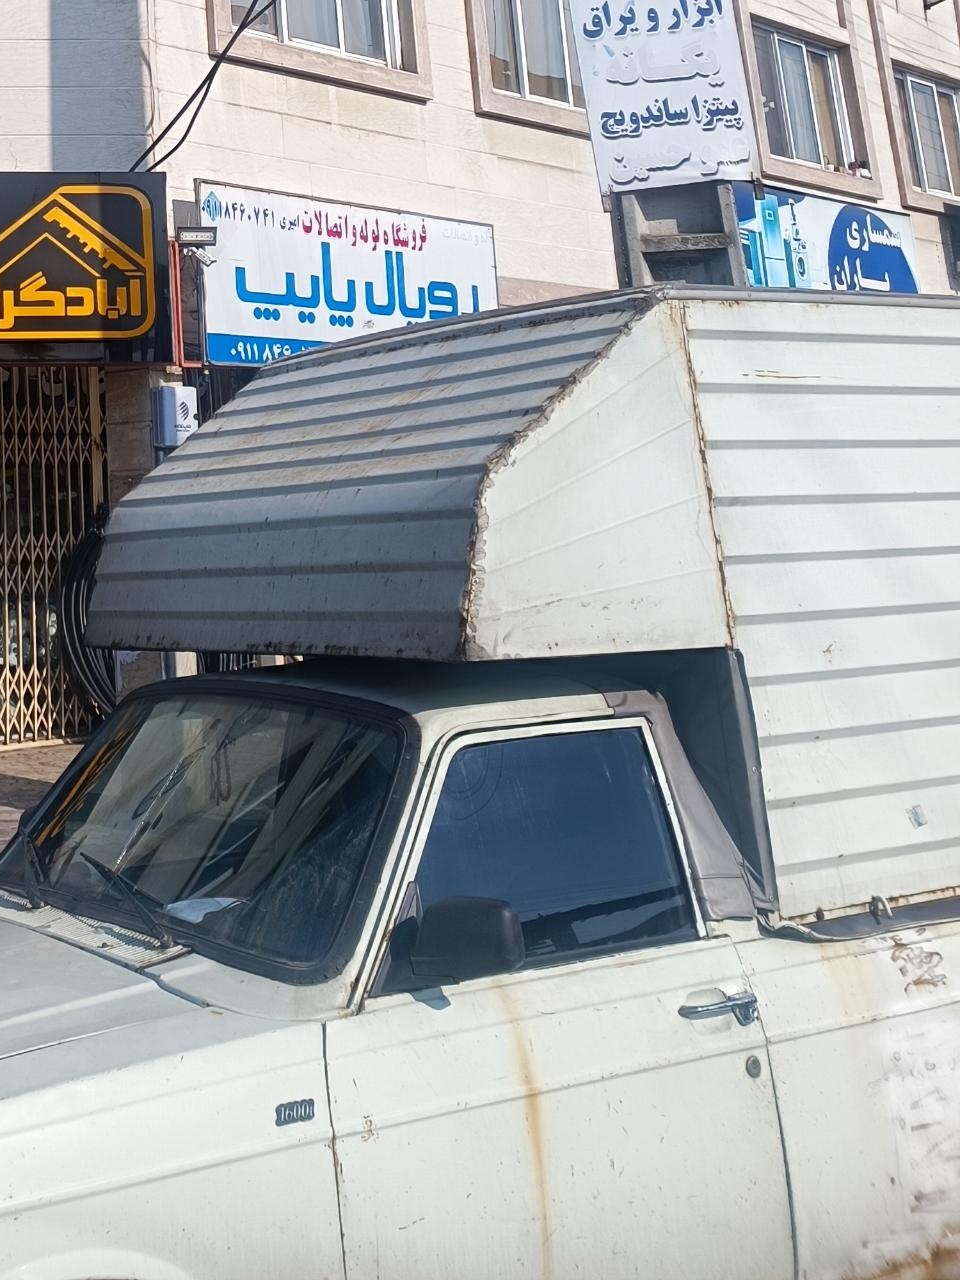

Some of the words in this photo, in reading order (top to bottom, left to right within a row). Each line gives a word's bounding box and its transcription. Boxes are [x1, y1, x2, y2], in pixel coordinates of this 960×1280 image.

[583, 0, 640, 39] یراق
[646, 7, 660, 33] و
[600, 97, 690, 138] ساندویچ
[692, 94, 744, 130] پیتزا
[201, 198, 276, 229] ۰۹۱۱۸۴۶۰۷۴۱
[302, 209, 349, 240] اتصالات
[351, 223, 358, 247] و
[359, 218, 380, 252] لوله
[383, 218, 428, 252] فروشگاه
[846, 213, 902, 252] سمساری
[235, 241, 357, 328] پایپ
[834, 255, 891, 292] باران
